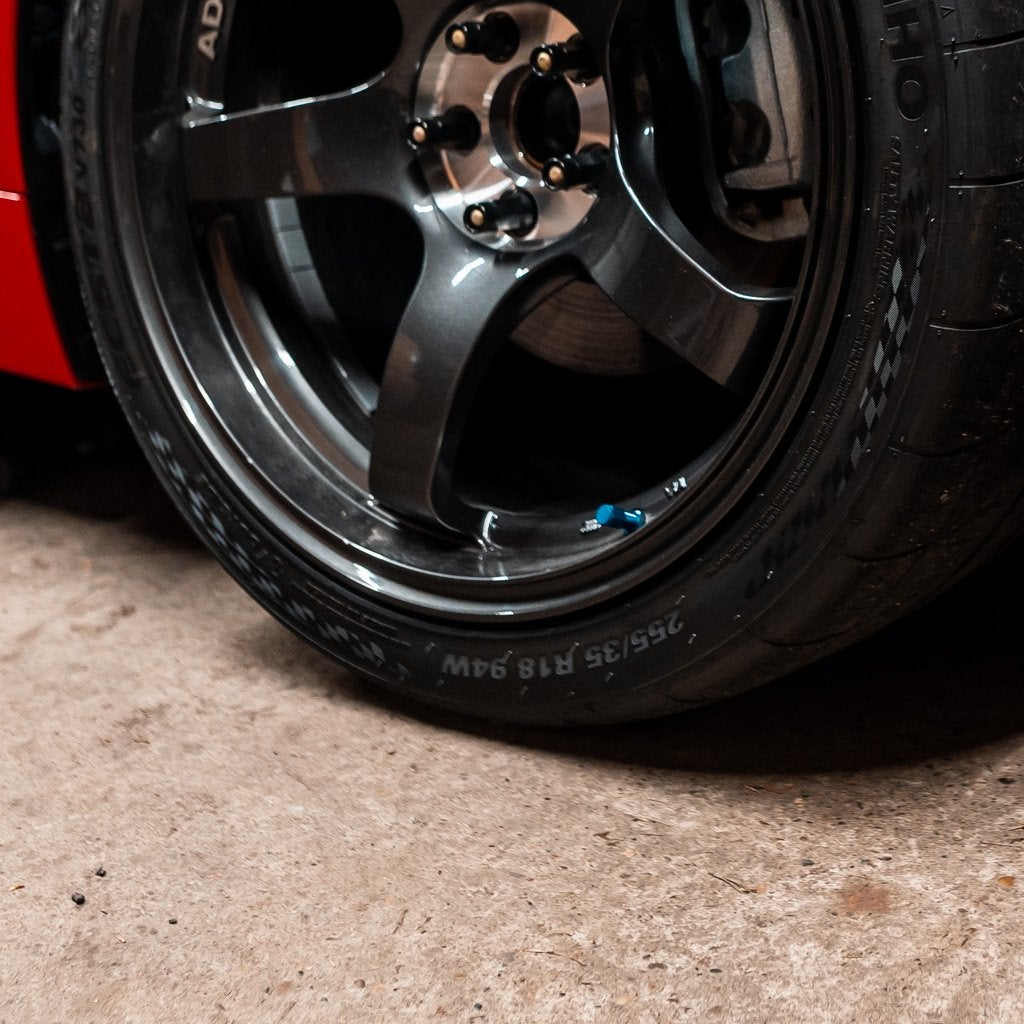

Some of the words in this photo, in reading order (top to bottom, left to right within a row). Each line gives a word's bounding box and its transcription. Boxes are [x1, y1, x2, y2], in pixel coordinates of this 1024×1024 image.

[583, 609, 685, 669] 255/35
[441, 654, 508, 680] 94W
[517, 653, 576, 680] R18
